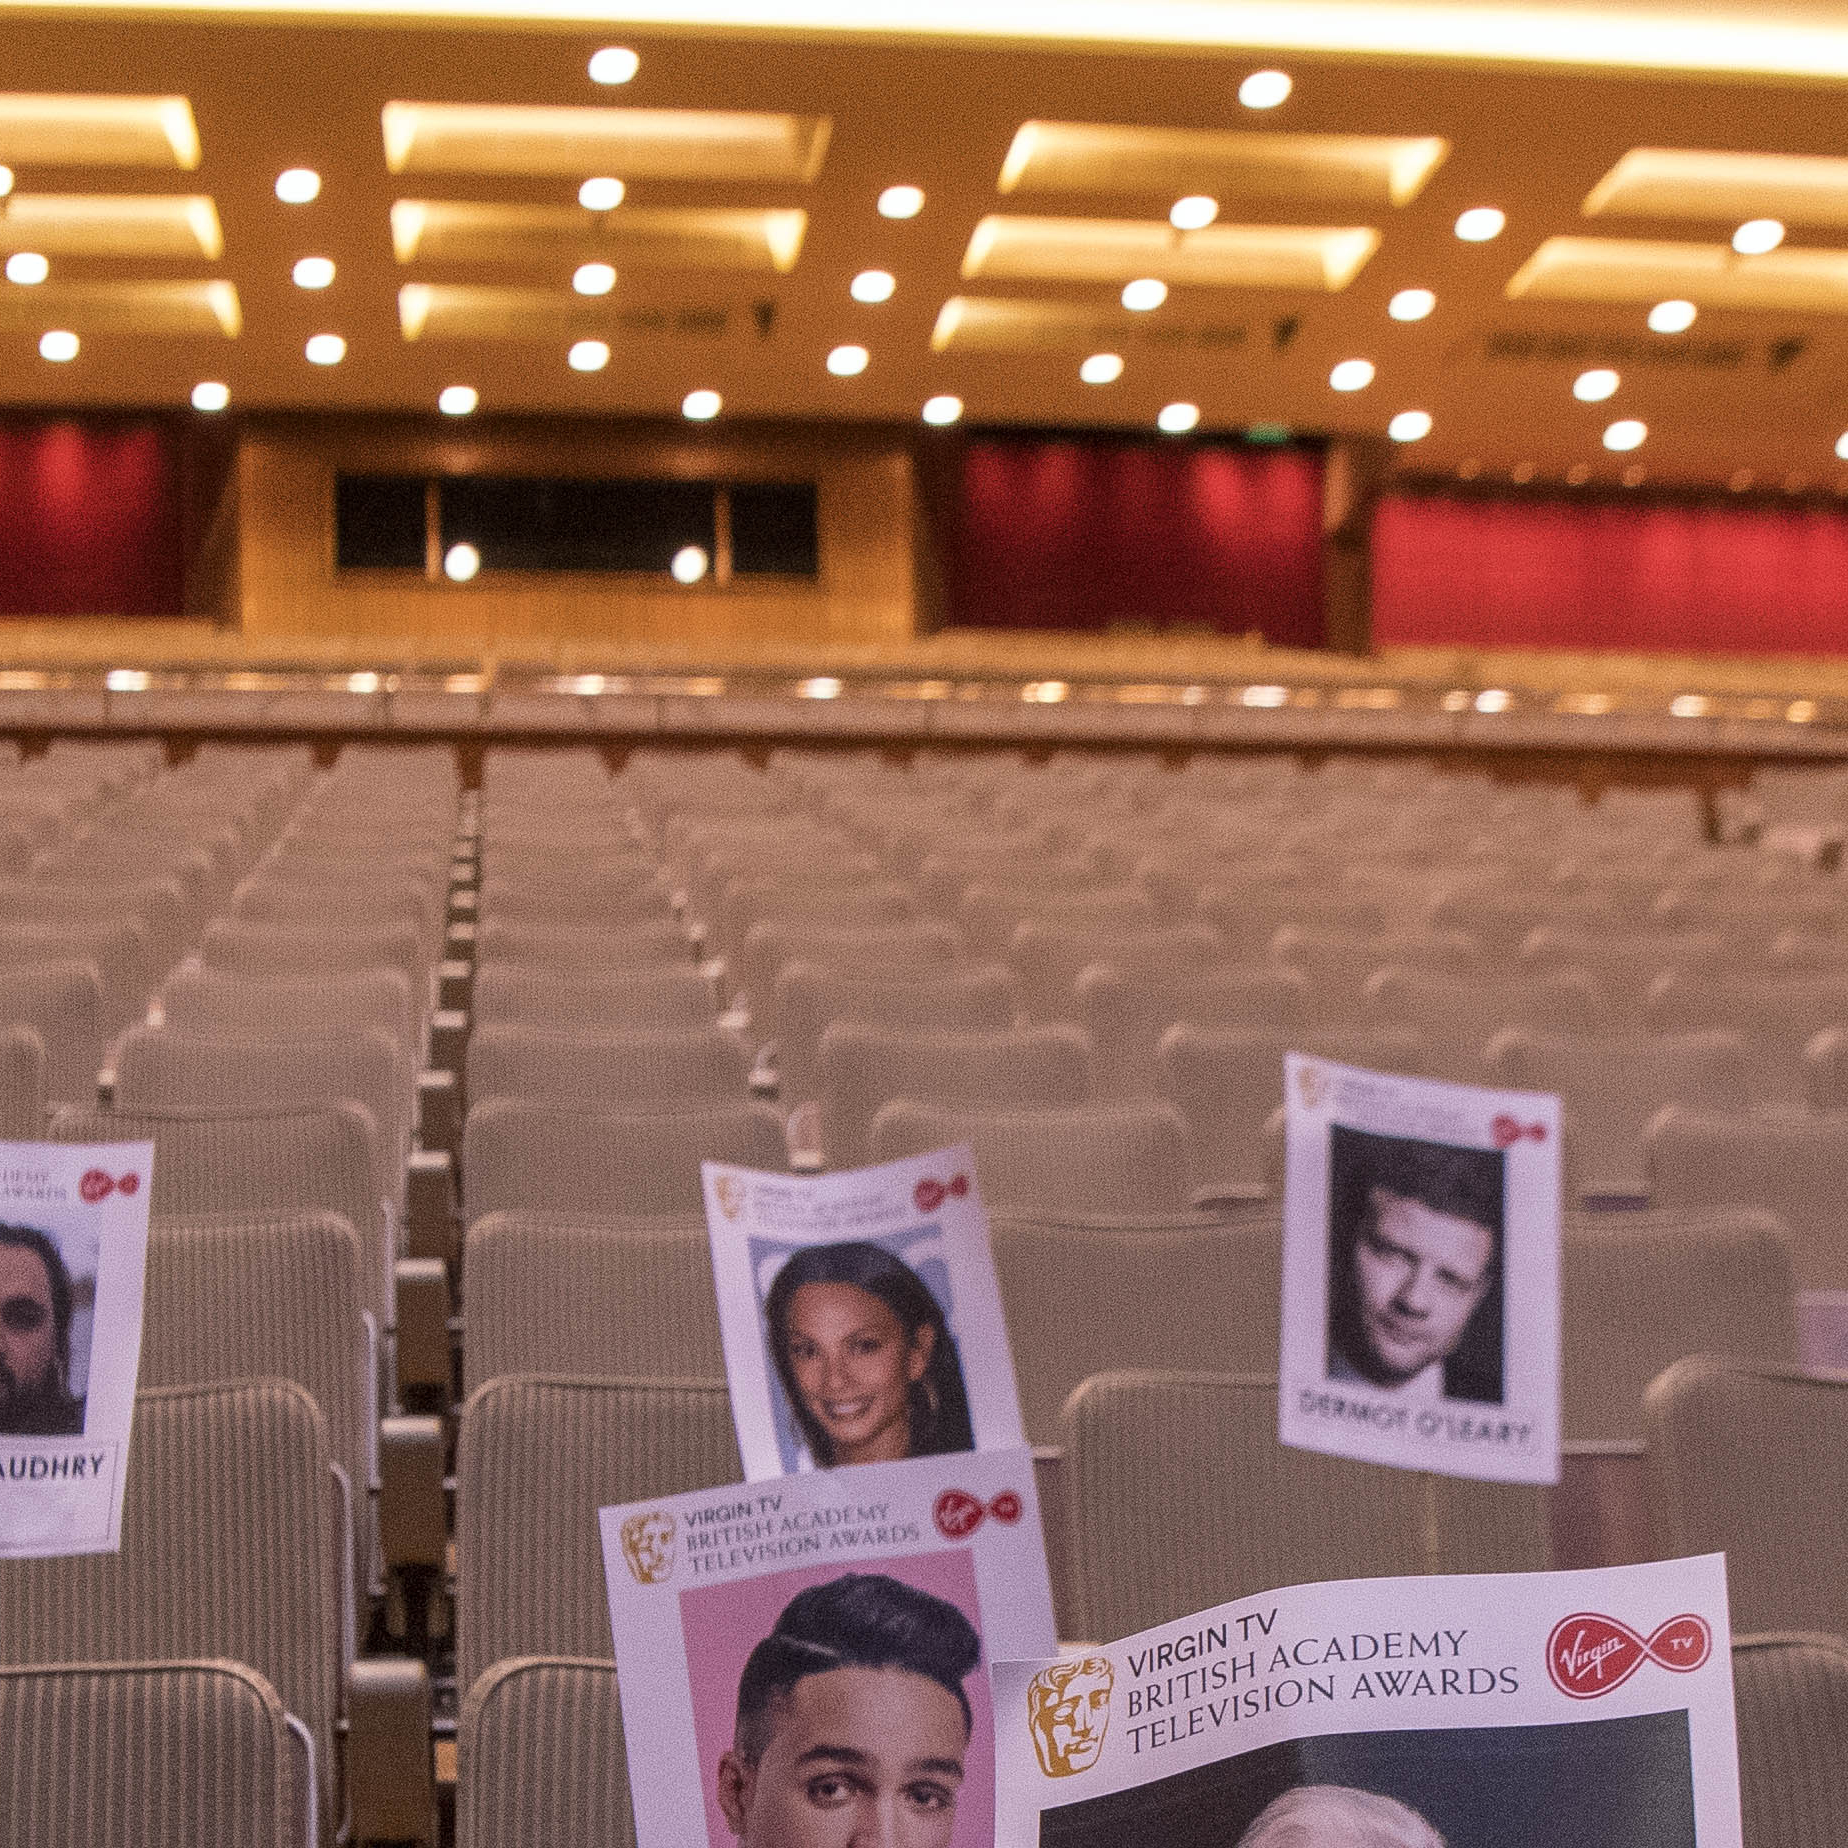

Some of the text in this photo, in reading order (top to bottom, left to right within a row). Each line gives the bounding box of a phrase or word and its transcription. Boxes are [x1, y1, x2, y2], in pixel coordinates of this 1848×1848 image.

[684, 1495, 782, 1529] VIRGIN TV
[686, 1503, 890, 1553] BRITISH ACADEMY
[690, 1522, 921, 1574] TELEVISION AWARDS
[1128, 1608, 1279, 1680] VIRGIN TV
[1560, 1630, 1694, 1680] Virgin TV
[1128, 1629, 1470, 1719] BRITISH ACADEMY
[1128, 1666, 1520, 1755] TELEVISION AWARDS
